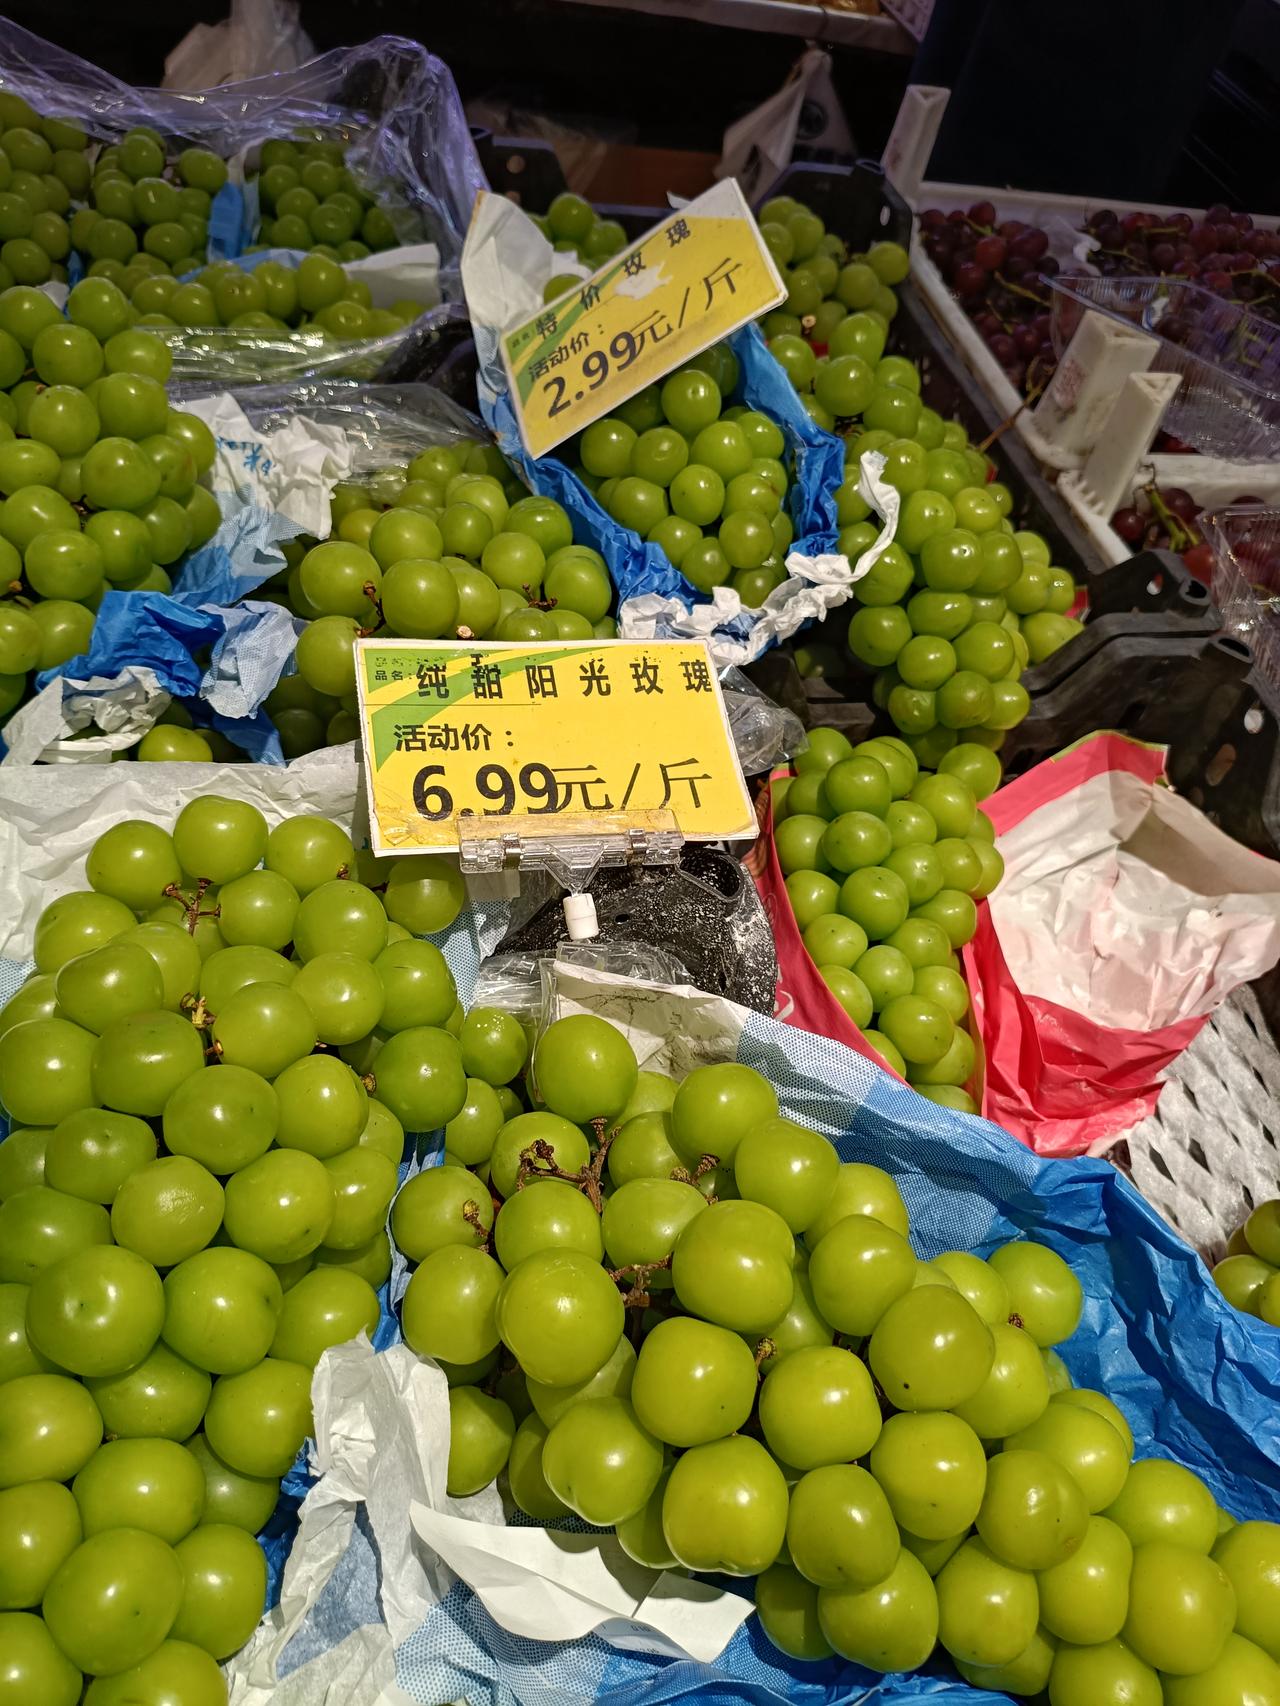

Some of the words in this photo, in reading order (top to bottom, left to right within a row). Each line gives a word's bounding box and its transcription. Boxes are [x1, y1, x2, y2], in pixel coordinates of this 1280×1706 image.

[535, 218, 691, 340] 特价玫瑰
[543, 257, 742, 418] 2.99元/斤
[416, 655, 713, 699] 纯甜阳光玫瑰
[394, 723, 513, 751] 活动价：
[413, 758, 712, 821] 6.99元/斤
